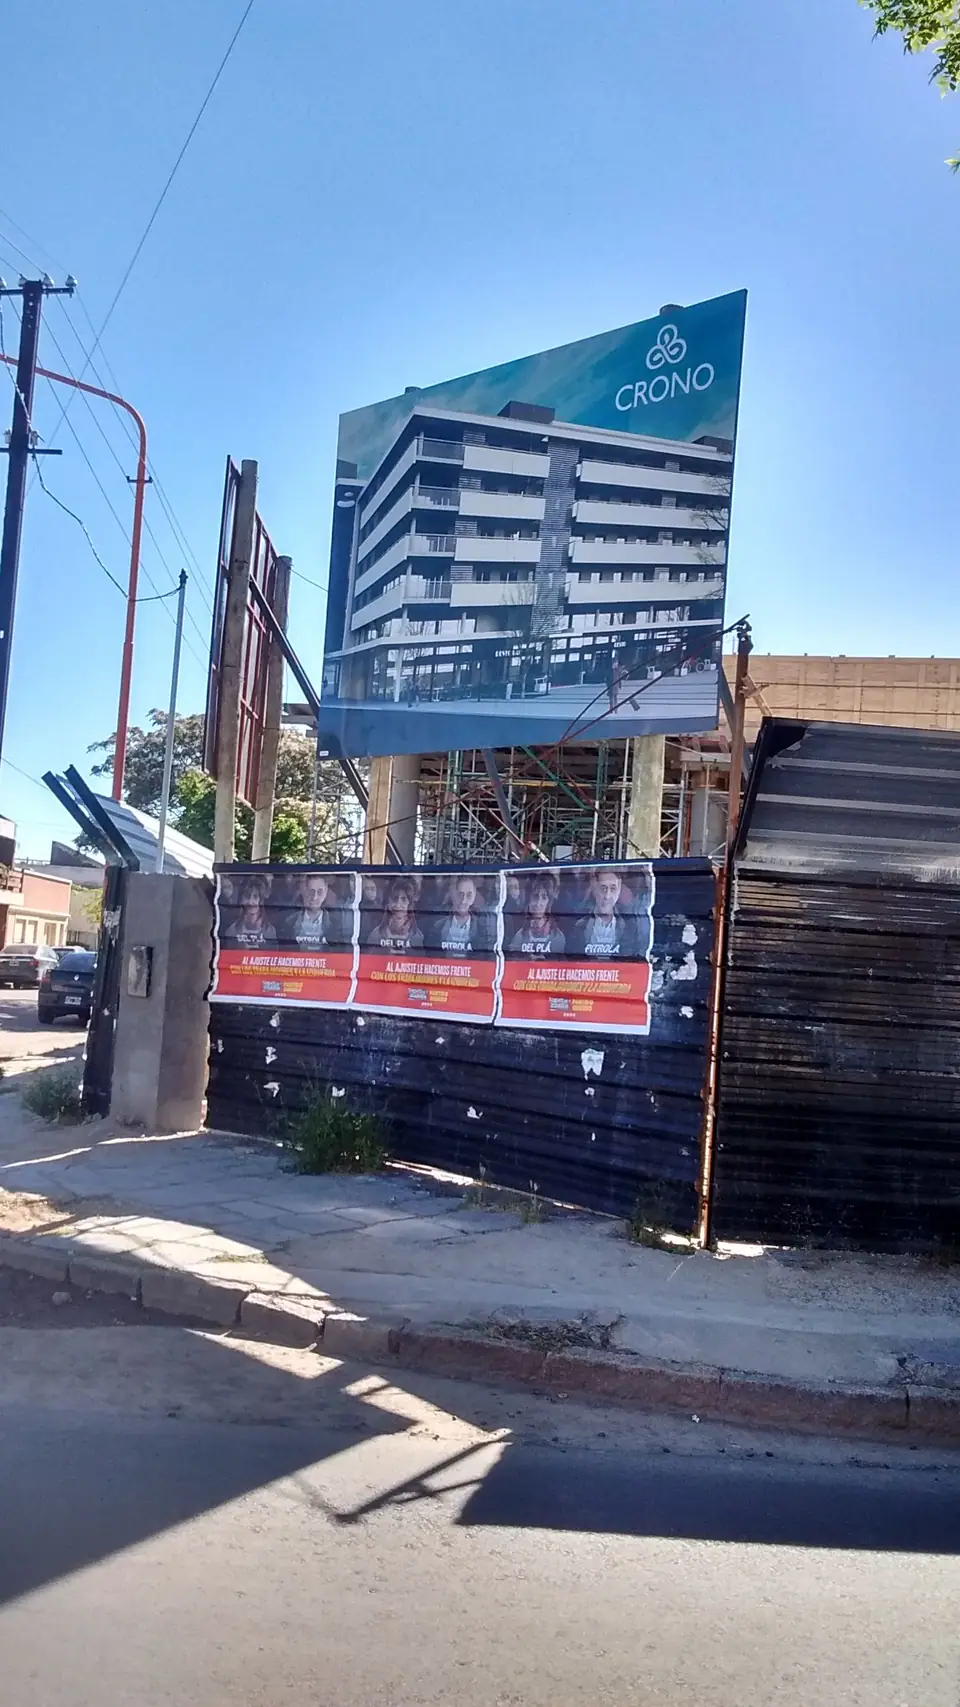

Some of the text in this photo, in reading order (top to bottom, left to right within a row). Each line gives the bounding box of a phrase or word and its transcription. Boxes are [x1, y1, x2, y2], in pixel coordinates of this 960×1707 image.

[615, 362, 715, 411] CRONO
[441, 941, 473, 951] PITROLA
[521, 941, 551, 952] DEL PLÁ
[584, 943, 620, 954] PITROLA
[278, 957, 305, 967] HACEMOS
[305, 958, 327, 969] FRENTE
[386, 961, 472, 978] AL AJUSTE LE HACEMOS FRENTE
[527, 968, 620, 982] AL AJUSTE LE HACEMOS FRENTE
